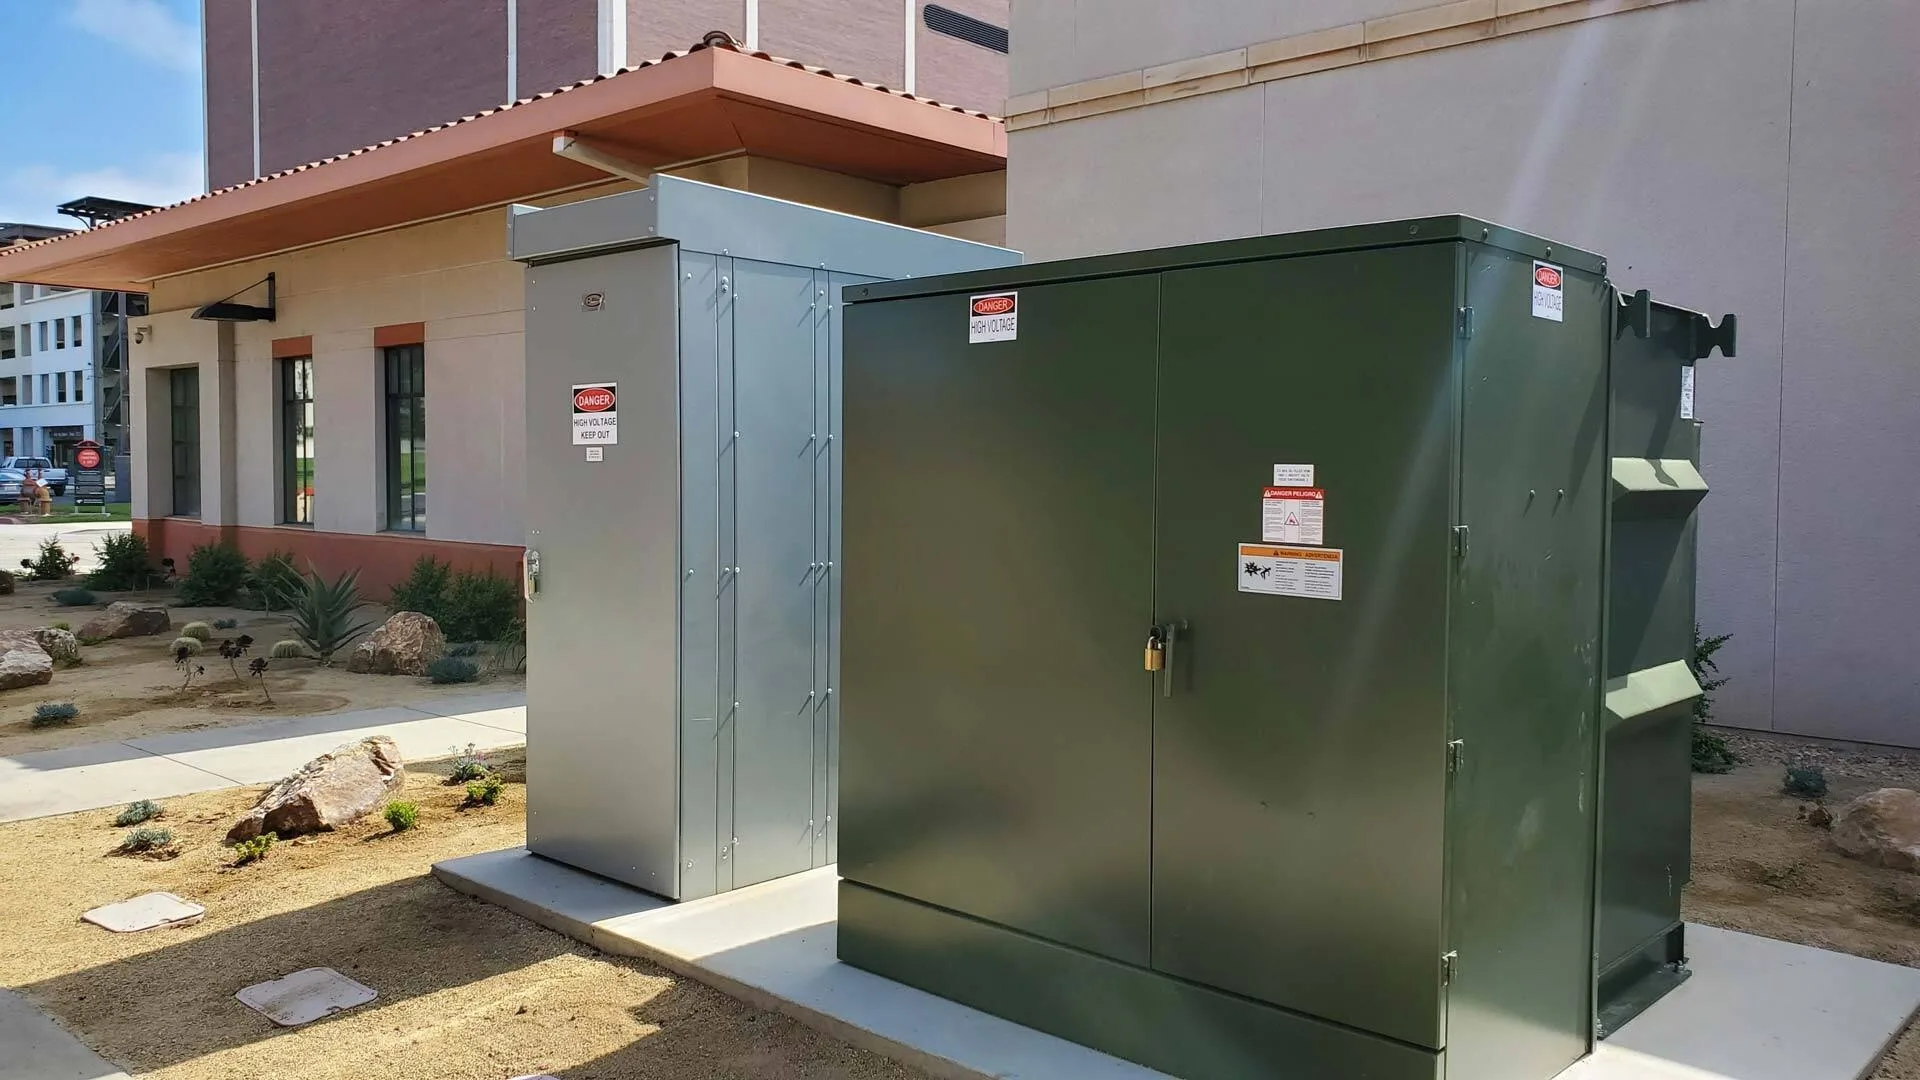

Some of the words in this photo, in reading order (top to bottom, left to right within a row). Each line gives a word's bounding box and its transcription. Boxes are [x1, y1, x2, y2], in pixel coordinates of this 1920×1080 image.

[1538, 270, 1559, 285] DANGER
[978, 300, 1008, 312] DANGER
[971, 320, 986, 334] HIGH
[987, 317, 1015, 332] VOLTAGE
[578, 394, 610, 407] DANGER
[574, 418, 588, 427] HIGH
[589, 417, 616, 427] VOLTAGE
[581, 431, 596, 439] KEEP
[598, 430, 610, 439] OUT
